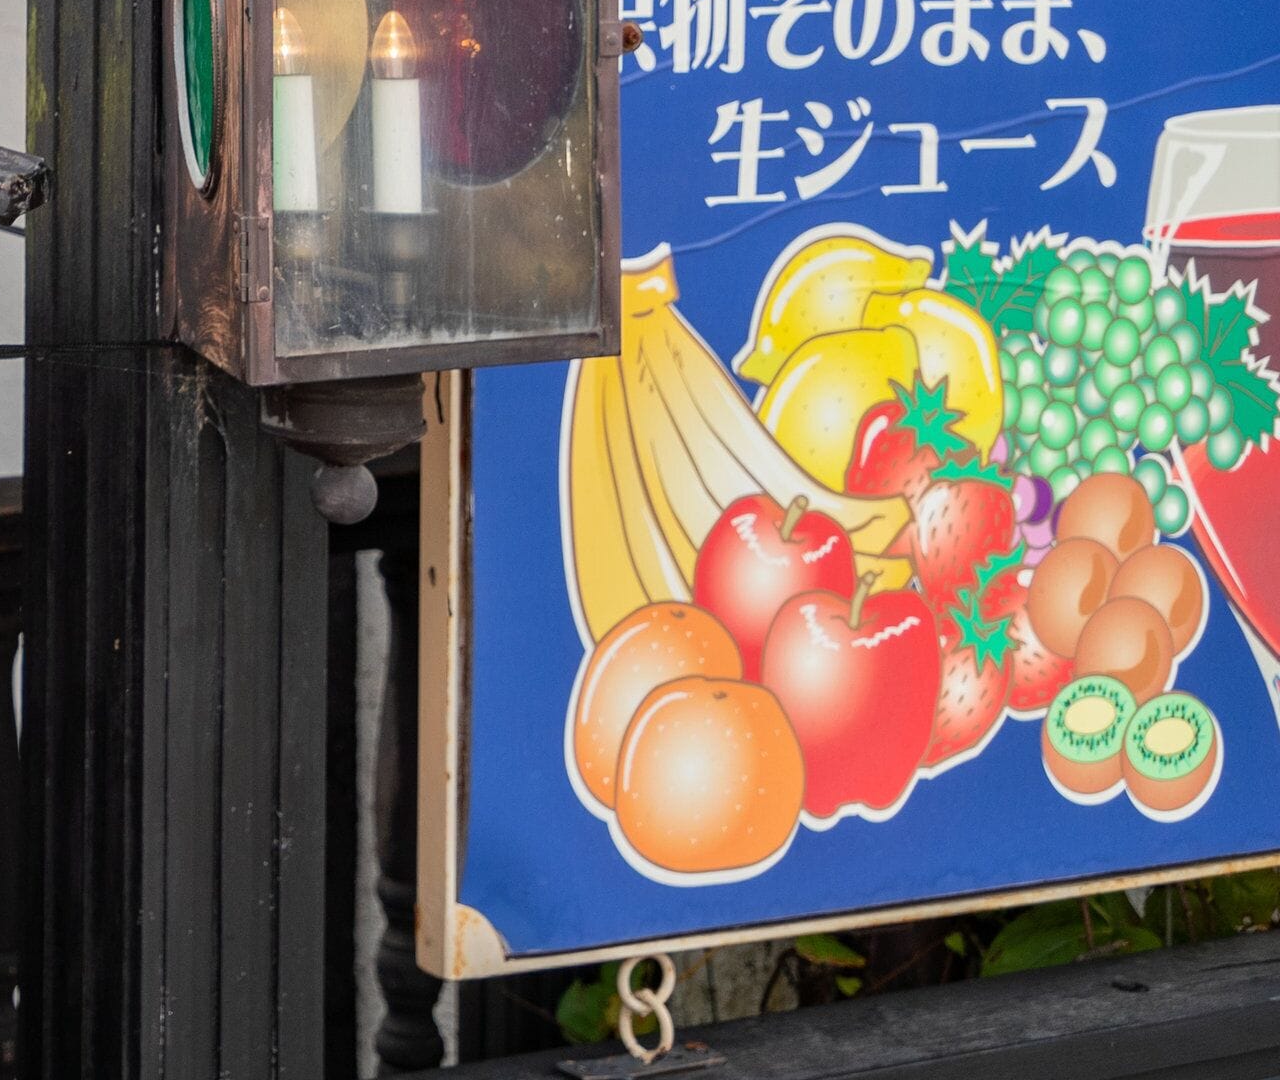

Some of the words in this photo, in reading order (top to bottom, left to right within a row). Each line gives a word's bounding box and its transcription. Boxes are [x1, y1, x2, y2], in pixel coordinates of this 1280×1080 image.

[705, 95, 1119, 208] 生ジュース
